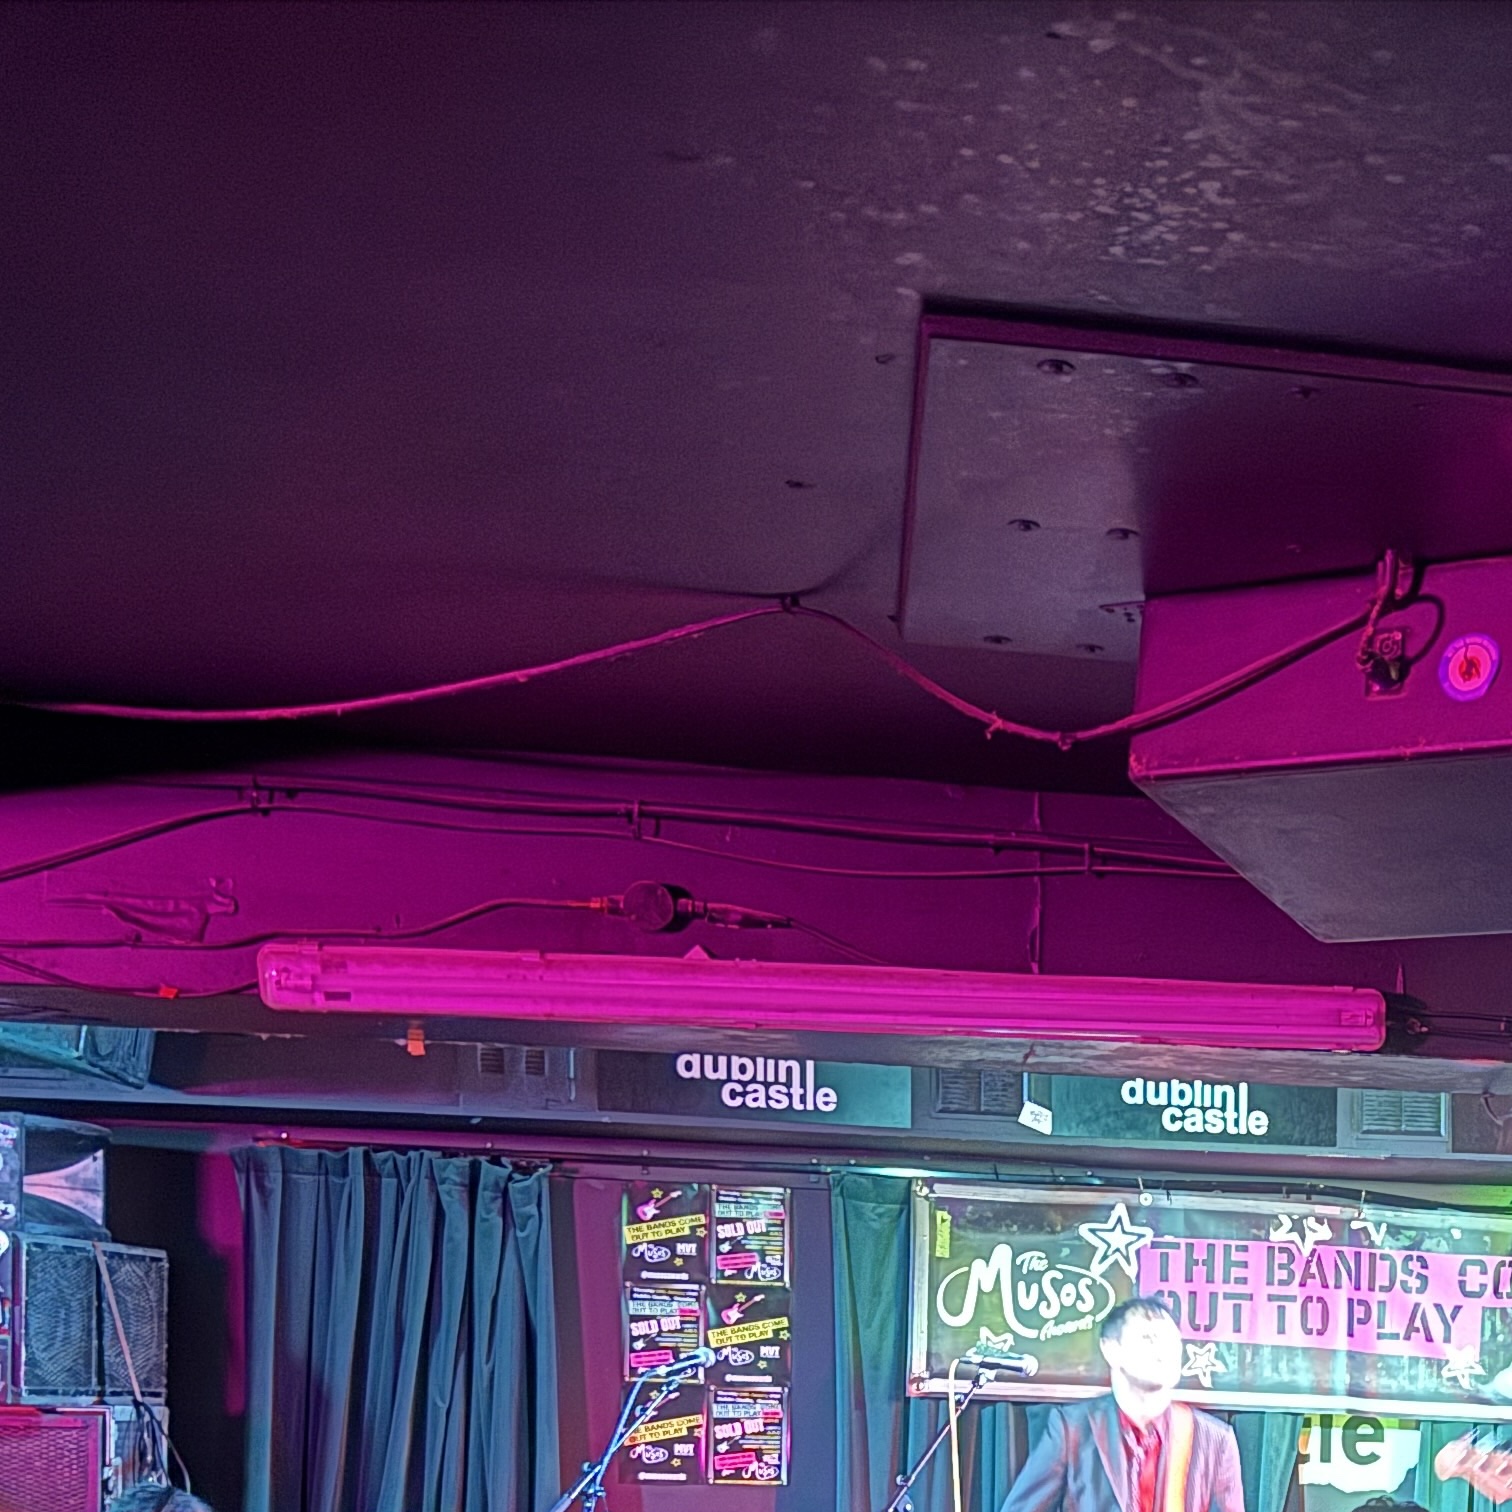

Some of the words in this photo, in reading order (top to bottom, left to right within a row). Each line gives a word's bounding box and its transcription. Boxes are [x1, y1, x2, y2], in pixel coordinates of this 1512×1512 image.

[721, 1060, 839, 1112] castle
[1121, 1078, 1235, 1108] dublin
[1161, 1082, 1269, 1136] castle
[627, 1225, 644, 1234] THE
[646, 1221, 677, 1231] BANDS
[679, 1217, 704, 1226] COME
[631, 1231, 649, 1241] OUT
[664, 1227, 686, 1236] PLAY
[1015, 1251, 1048, 1274] The
[1150, 1241, 1249, 1286] THE
[1266, 1245, 1430, 1295] BANDS
[711, 1329, 729, 1338] THE
[731, 1325, 760, 1334] BANDS
[762, 1319, 786, 1328] COME
[1267, 1294, 1331, 1336] TO
[1347, 1299, 1464, 1344] PLAY
[716, 1335, 733, 1344] OUT
[748, 1330, 769, 1339] PLAY
[644, 1421, 674, 1431] BANDS
[662, 1428, 683, 1437] PLAY
